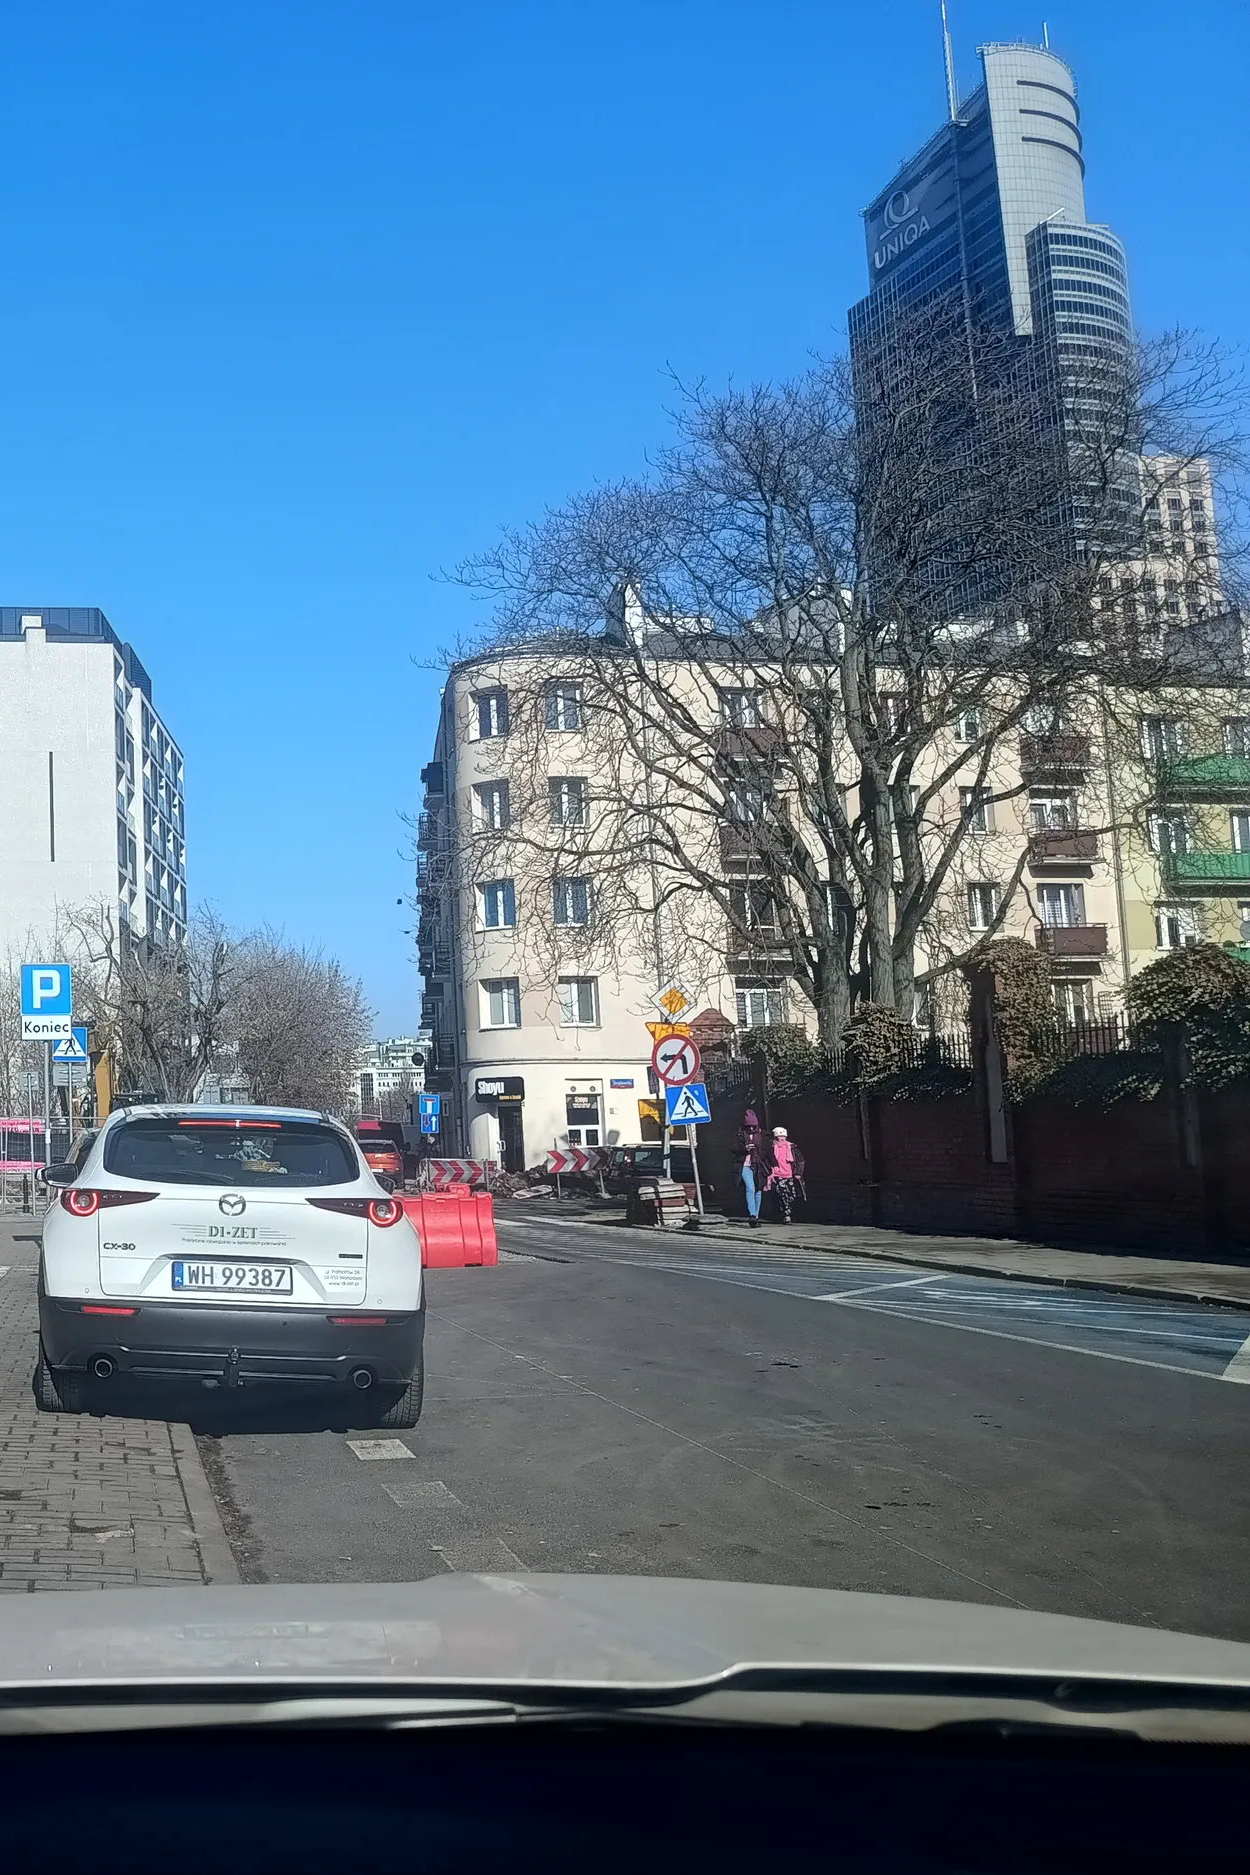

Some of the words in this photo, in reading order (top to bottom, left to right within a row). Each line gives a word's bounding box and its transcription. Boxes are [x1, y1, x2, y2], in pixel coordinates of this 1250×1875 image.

[873, 215, 931, 269] UNIQA
[32, 969, 61, 1009] P
[24, 1021, 70, 1034] Koniec
[477, 1081, 505, 1097] Shoyu
[208, 1225, 258, 1239] DI-ZET
[103, 1242, 136, 1251] CX-30
[188, 1265, 214, 1285] WH
[221, 1266, 286, 1288] 99387
